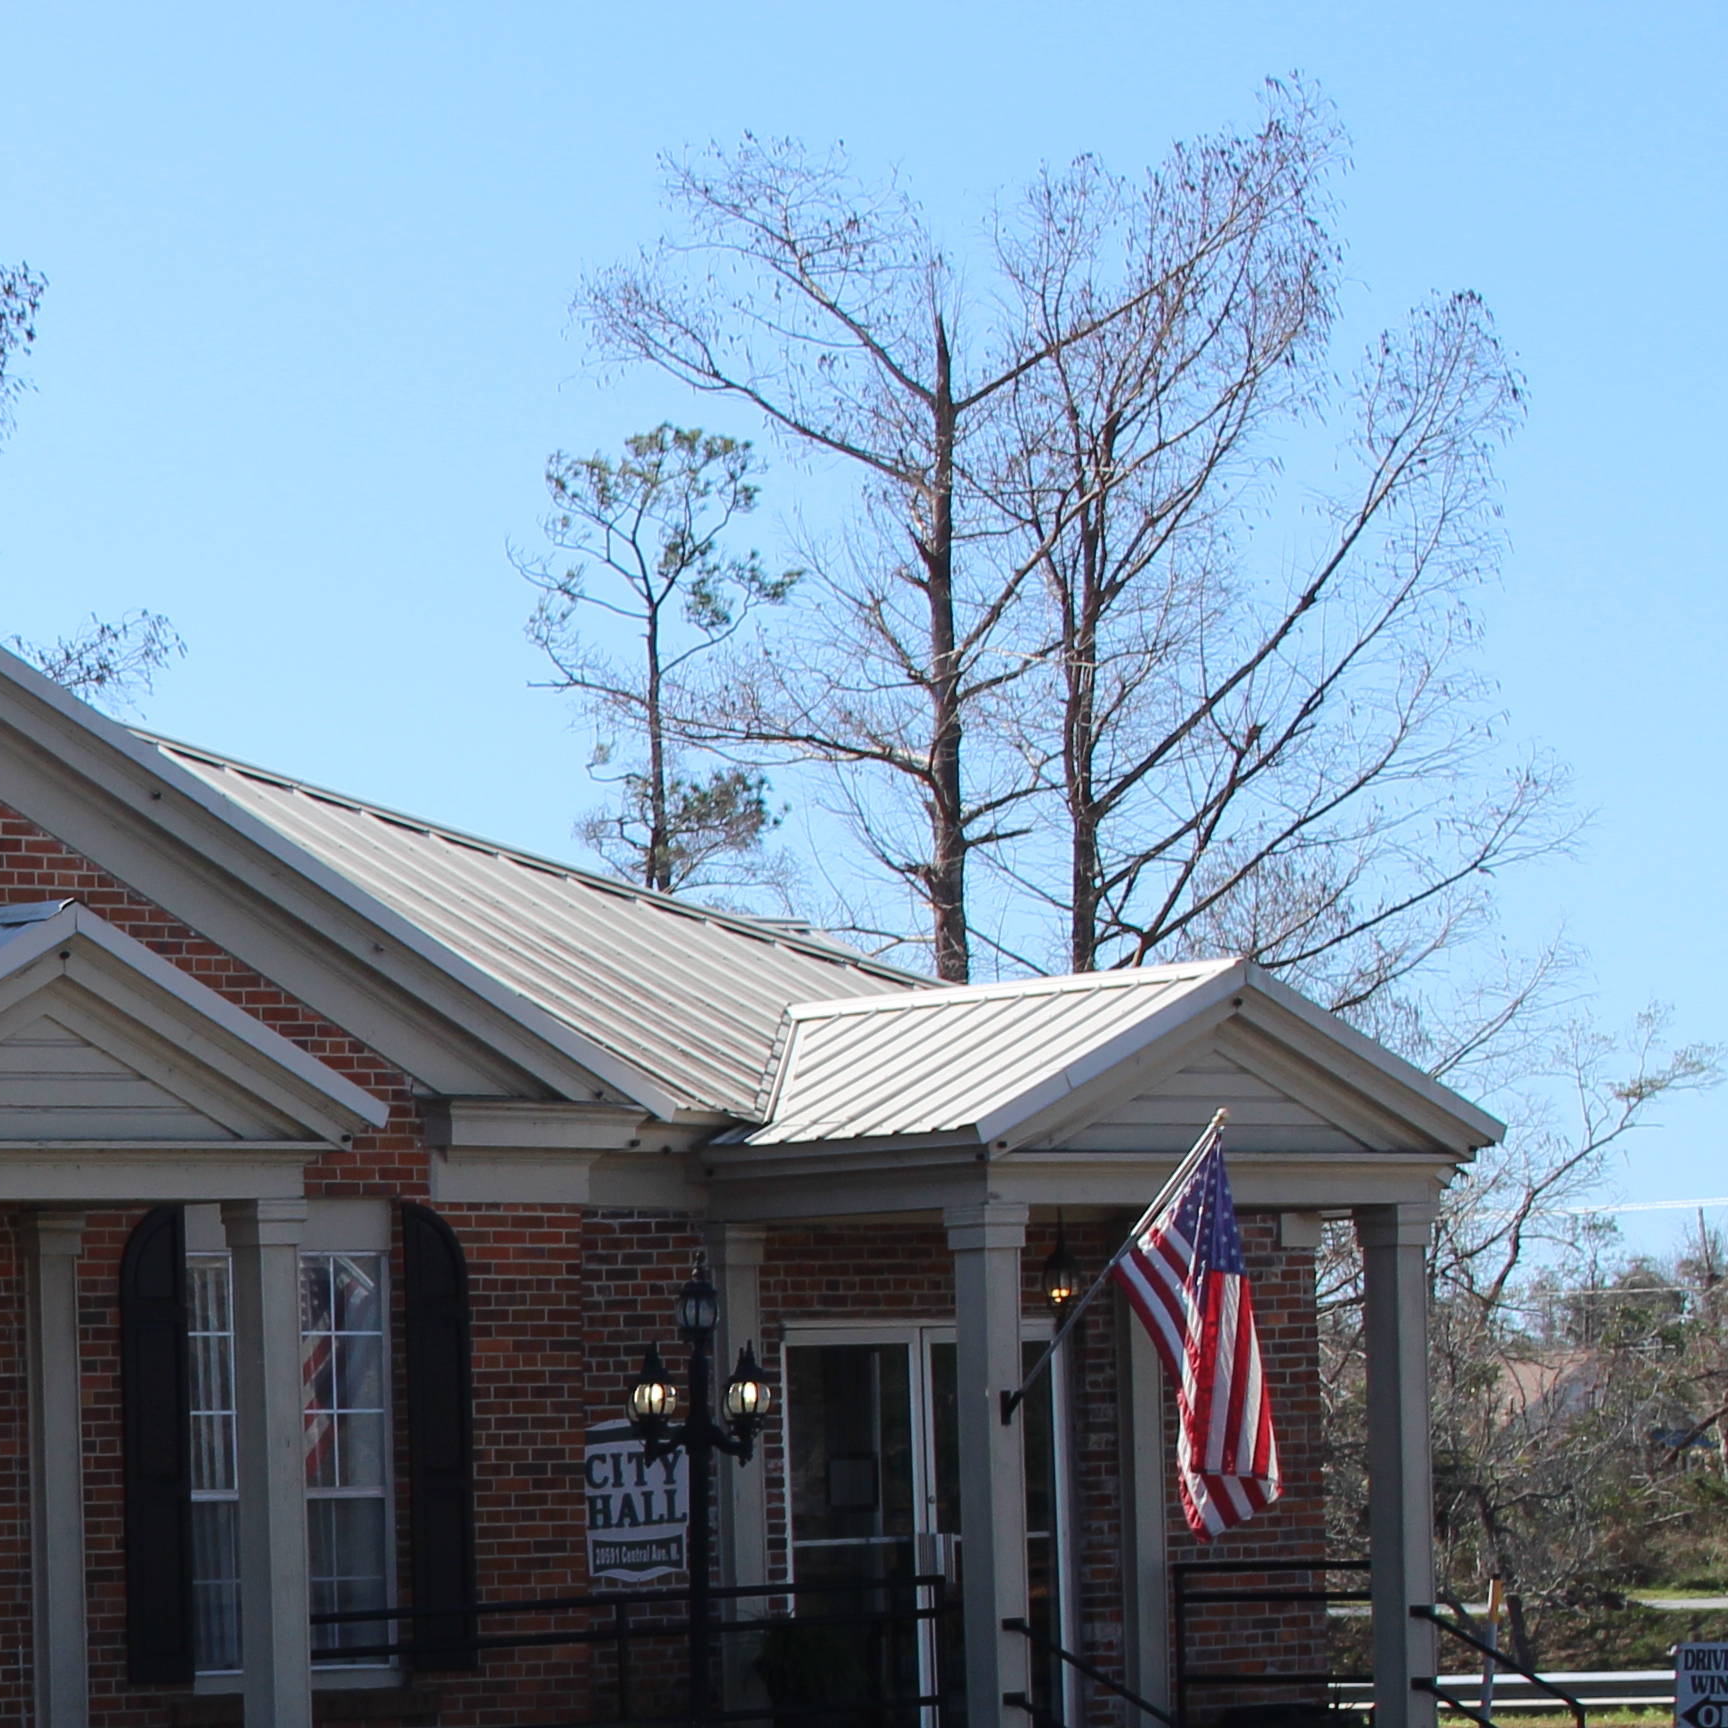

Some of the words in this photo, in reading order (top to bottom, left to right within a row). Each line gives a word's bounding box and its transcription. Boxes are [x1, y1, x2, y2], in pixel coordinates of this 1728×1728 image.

[586, 1450, 683, 1489] CITY
[587, 1488, 687, 1530] HALL
[622, 1544, 650, 1563] Central
